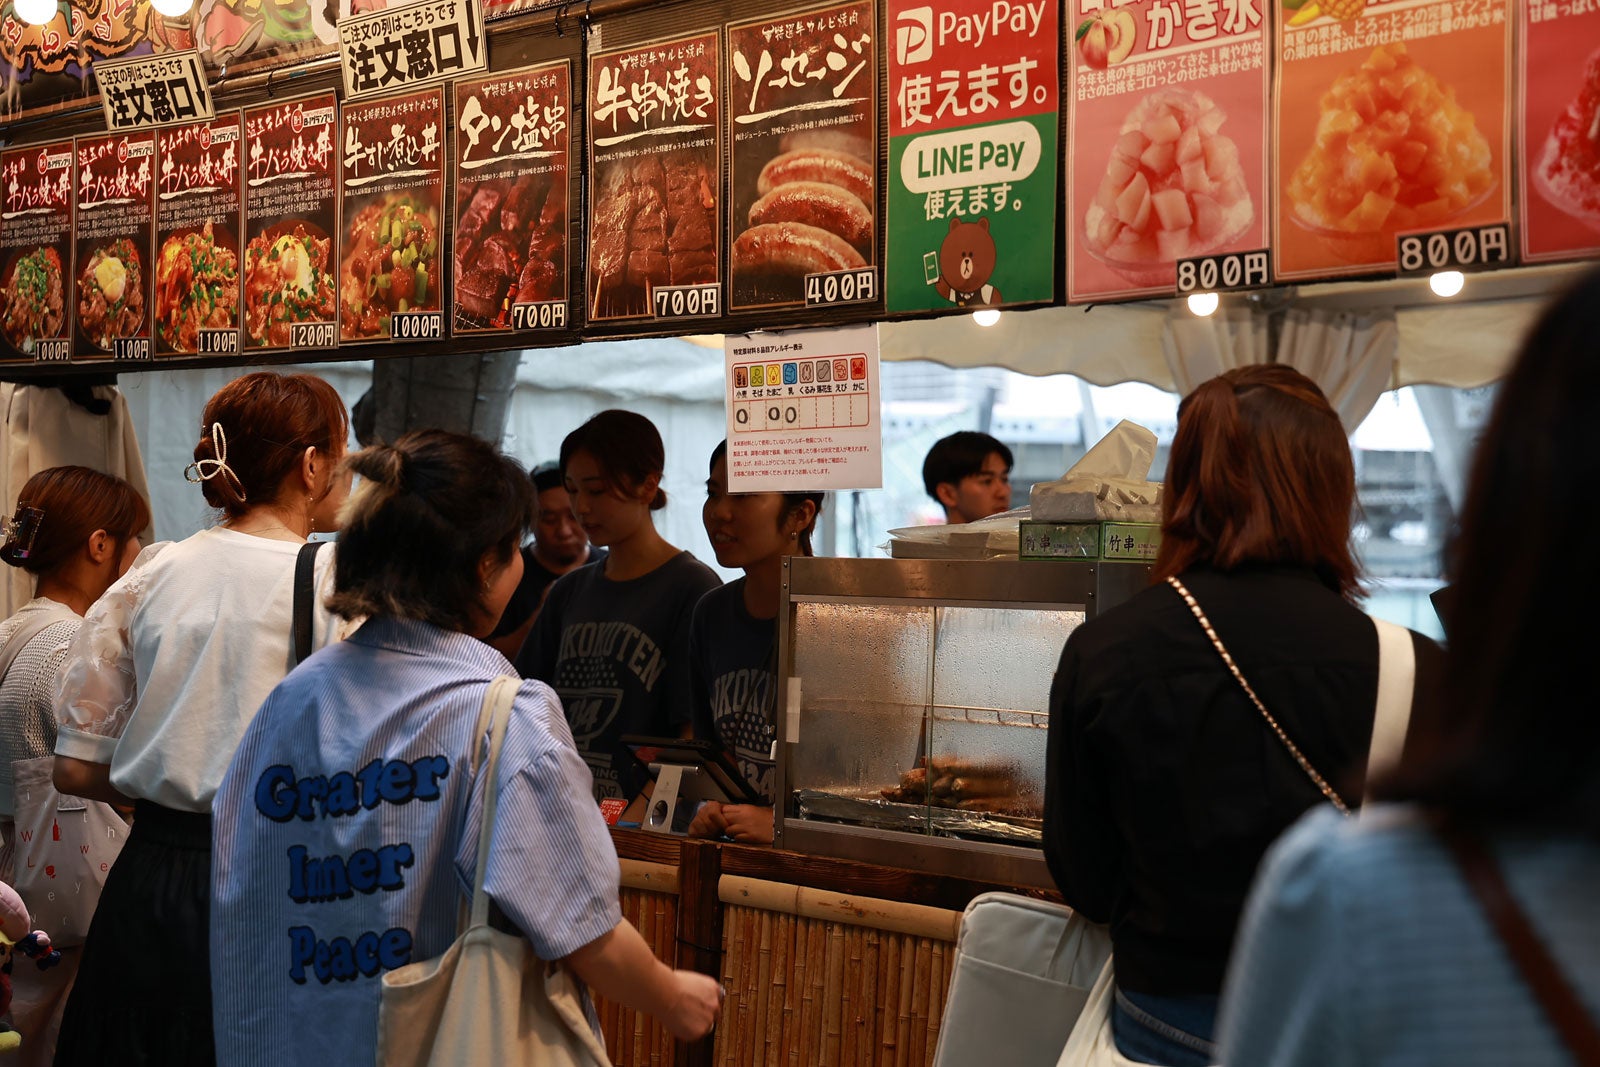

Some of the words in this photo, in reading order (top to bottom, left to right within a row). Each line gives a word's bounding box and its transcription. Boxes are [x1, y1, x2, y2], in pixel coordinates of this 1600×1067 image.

[342, 1, 457, 45] ご注文の列はこちらです
[939, 0, 1046, 48] PayPay
[99, 58, 183, 87] ご注文の列はこちらです
[350, 22, 464, 93] 注文窓口
[733, 33, 871, 112] ソーセージ
[105, 77, 198, 128] 注文窓口
[594, 62, 713, 132] 牛串焼き
[897, 56, 1047, 128] 使えます。
[460, 95, 566, 161] タン塩串
[918, 143, 974, 179] LINE
[979, 140, 1026, 172] Pay
[924, 183, 1022, 221] 使えます。
[1401, 227, 1507, 271] 800円
[807, 270, 874, 303] 400円
[1178, 252, 1268, 293] 800円
[513, 303, 566, 329] 700円
[656, 288, 718, 316] 700円
[199, 332, 237, 353] 1100円
[291, 325, 334, 347] 1200円
[394, 315, 440, 338] 1000円
[36, 341, 69, 361] 1000円
[114, 339, 149, 360] 1100円
[752, 389, 763, 397] そば
[766, 388, 782, 396] たまご
[800, 386, 816, 394] くるみ
[835, 384, 847, 392] えび
[853, 383, 865, 391] かに
[1109, 534, 1136, 553] 竹串
[288, 925, 413, 985] Peace
